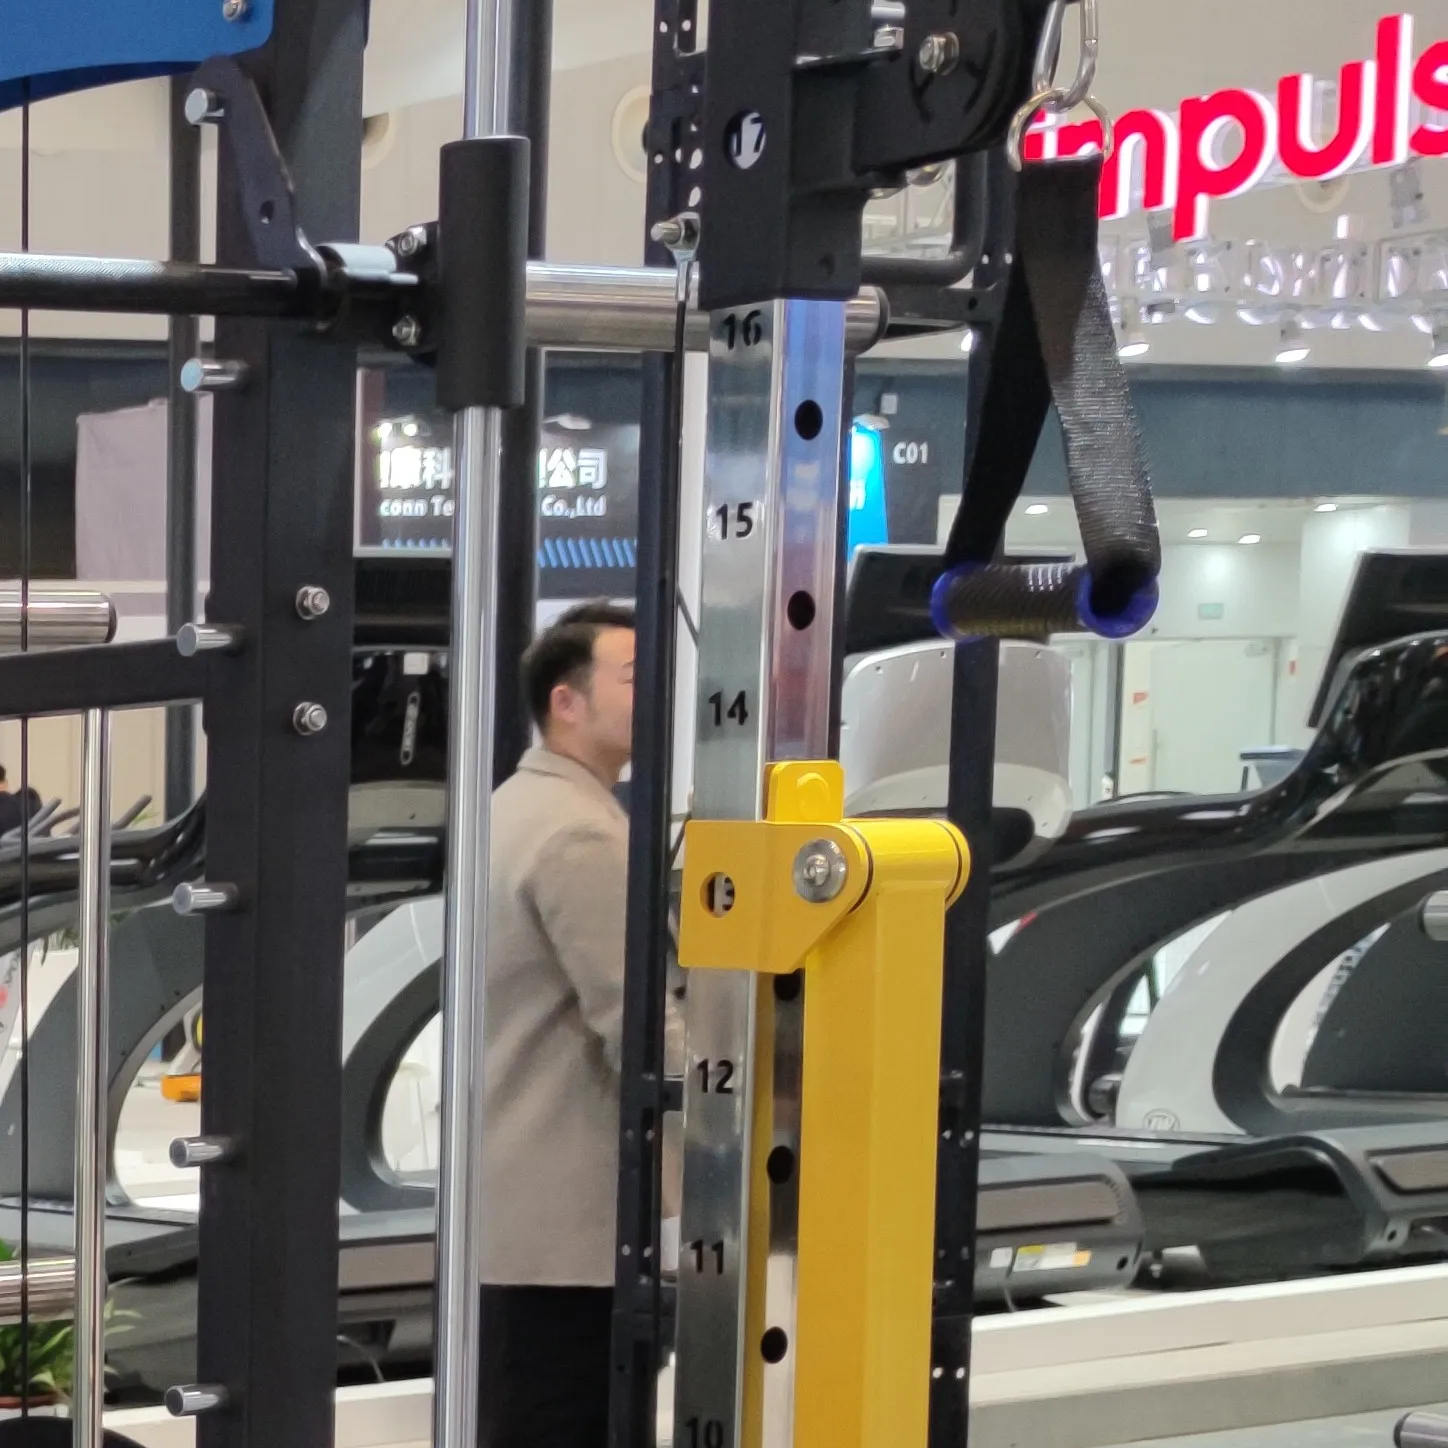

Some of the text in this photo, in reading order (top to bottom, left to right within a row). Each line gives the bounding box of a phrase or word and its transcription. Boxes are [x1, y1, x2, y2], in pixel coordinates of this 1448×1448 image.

[721, 311, 762, 349] 16
[893, 441, 929, 464] C01
[715, 502, 755, 540] 15
[708, 691, 749, 728] 14
[696, 1059, 735, 1095] 12
[689, 1239, 726, 1275] 11
